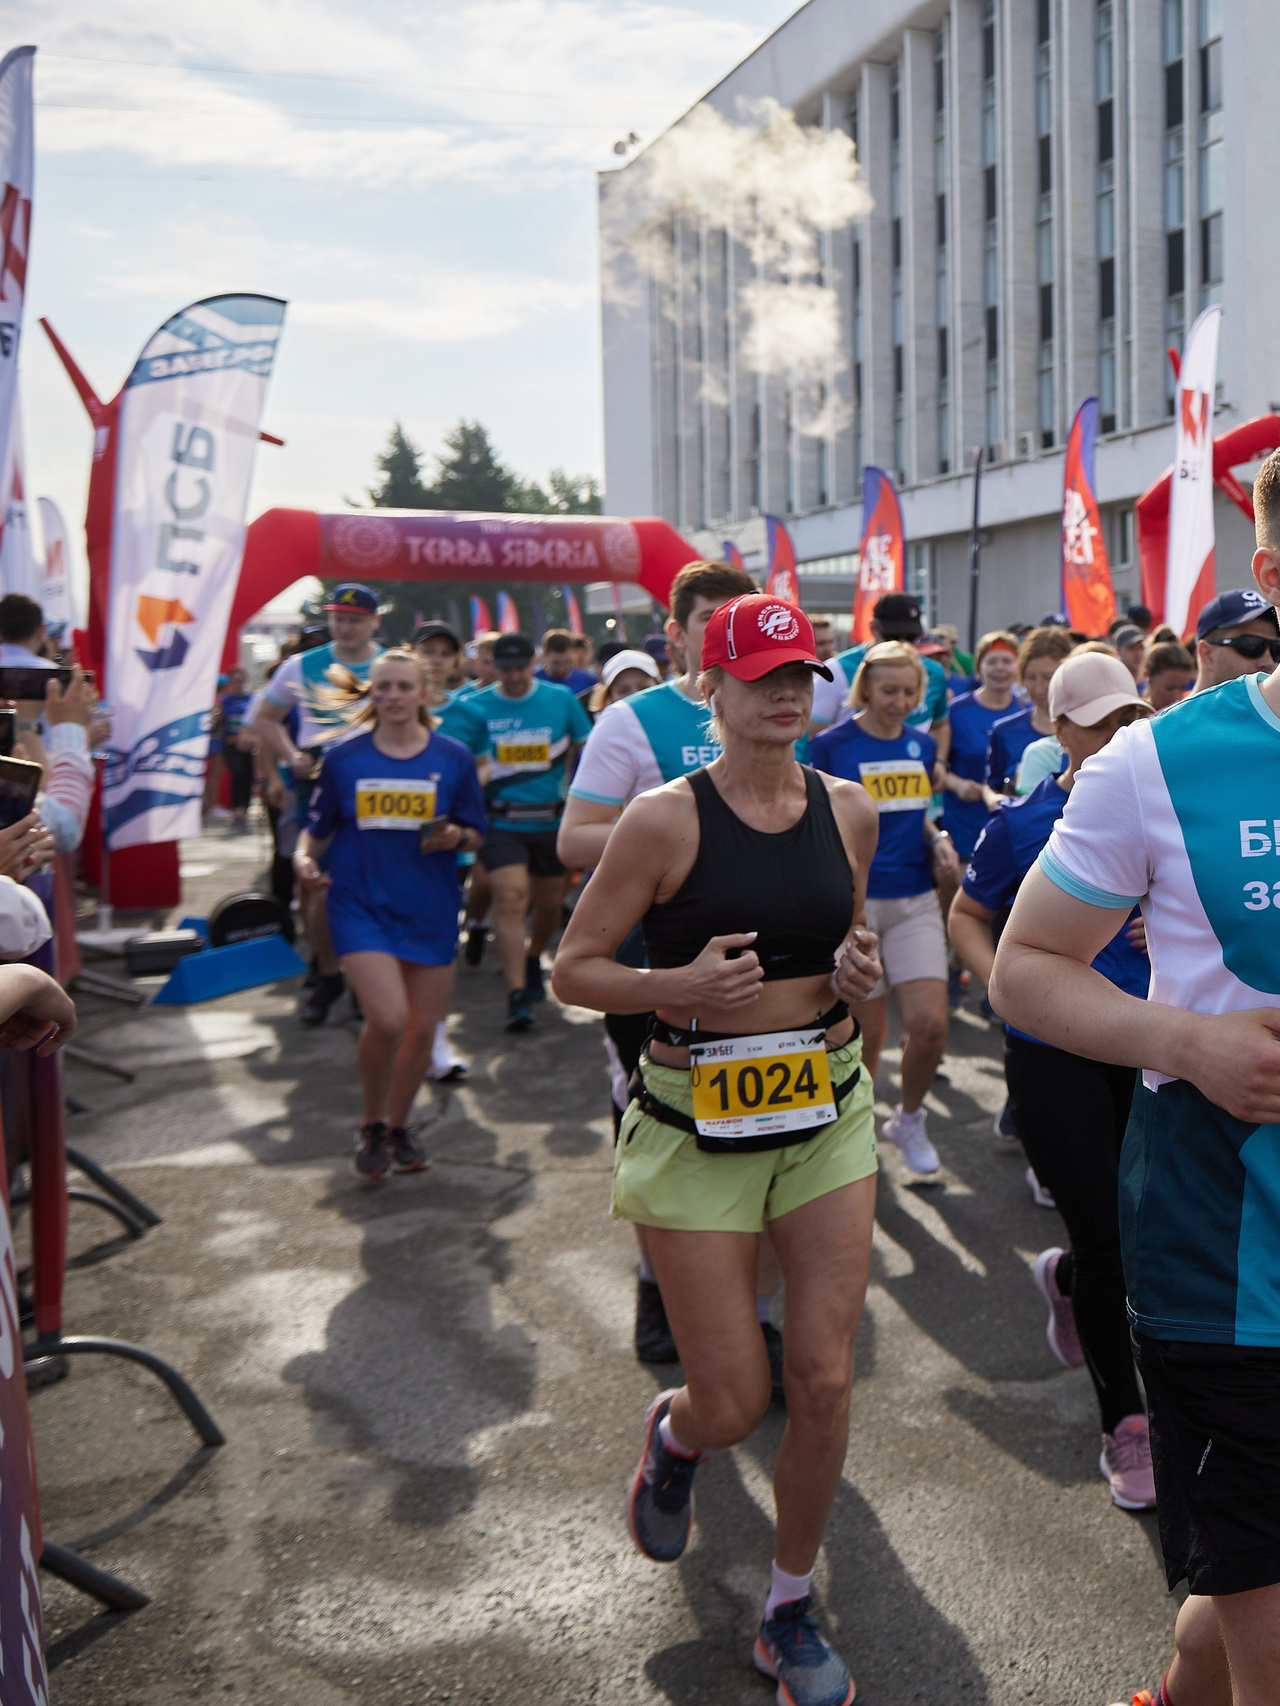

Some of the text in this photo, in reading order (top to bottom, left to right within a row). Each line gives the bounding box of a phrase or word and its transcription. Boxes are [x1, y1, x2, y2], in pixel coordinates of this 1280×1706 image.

[157, 422, 216, 575] ПСБ
[405, 536, 494, 566] TERRA
[872, 775, 922, 797] 1077
[366, 793, 426, 816] 1003
[709, 1058, 819, 1111] 1024
